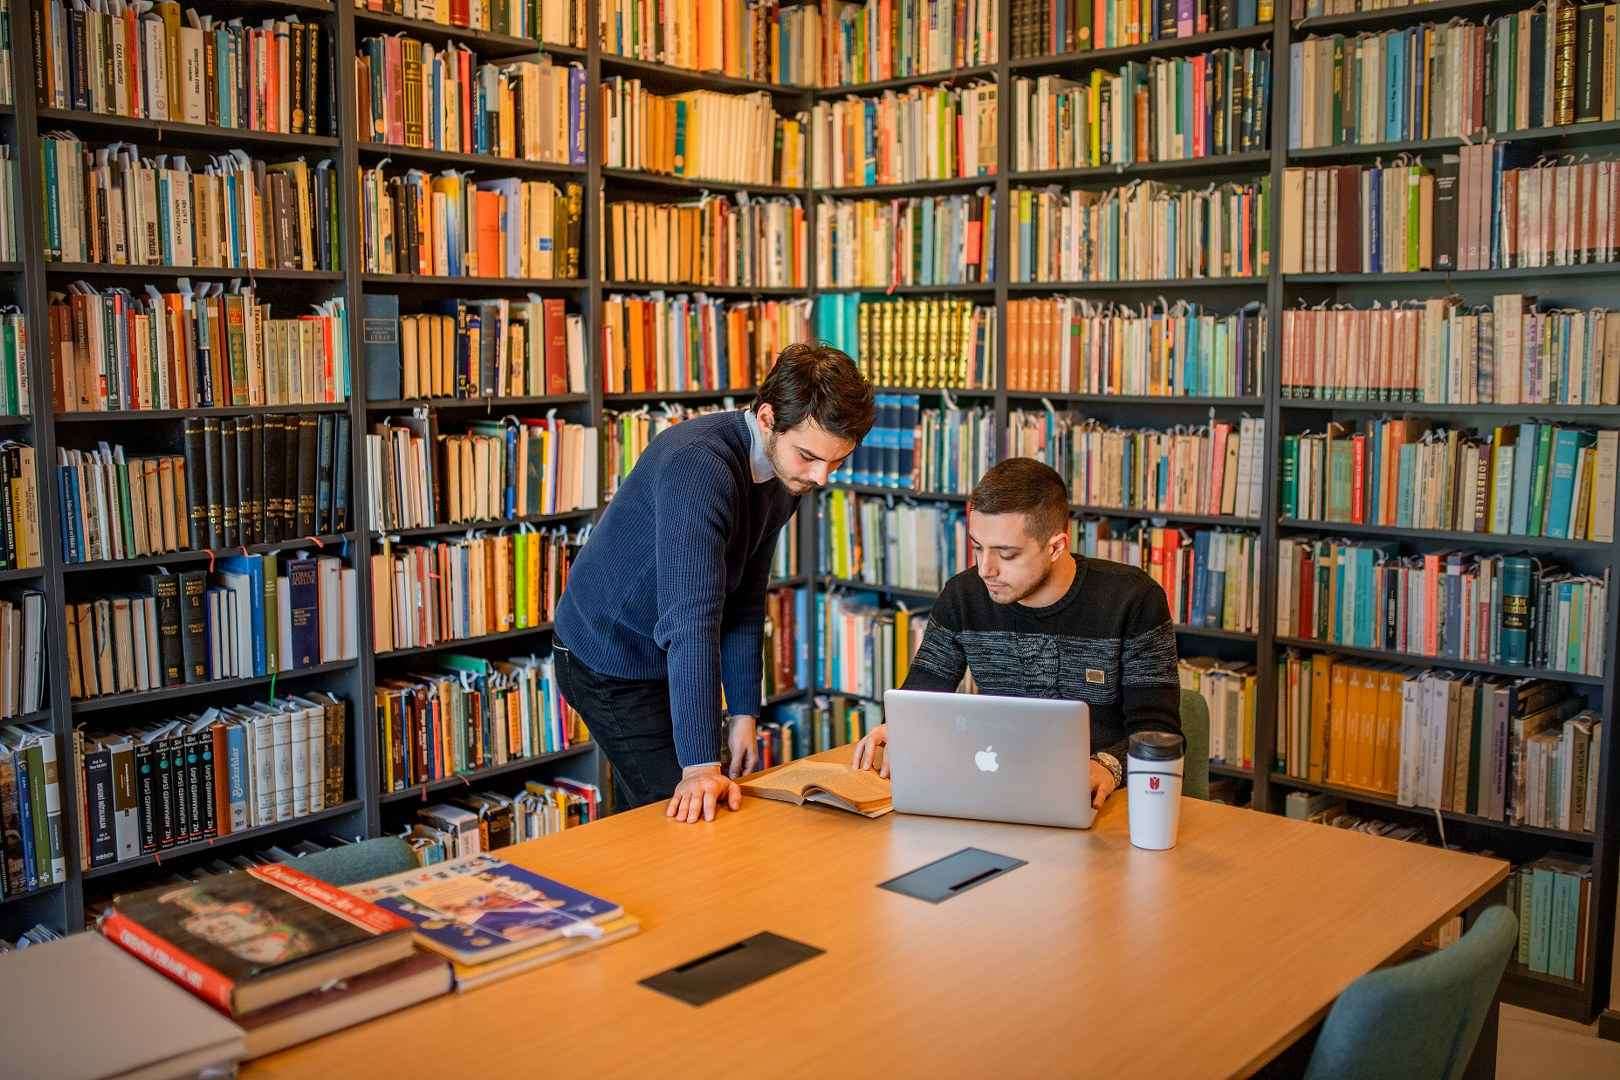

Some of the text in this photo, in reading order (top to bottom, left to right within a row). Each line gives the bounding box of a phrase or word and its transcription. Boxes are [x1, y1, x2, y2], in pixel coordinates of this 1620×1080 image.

[255, 333, 261, 342] TO
[1475, 459, 1488, 519] SOHBETLER
[145, 795, 153, 833] MUHAMMED
[163, 791, 171, 827] MUHAMMED
[191, 784, 199, 820] MUHAMMED
